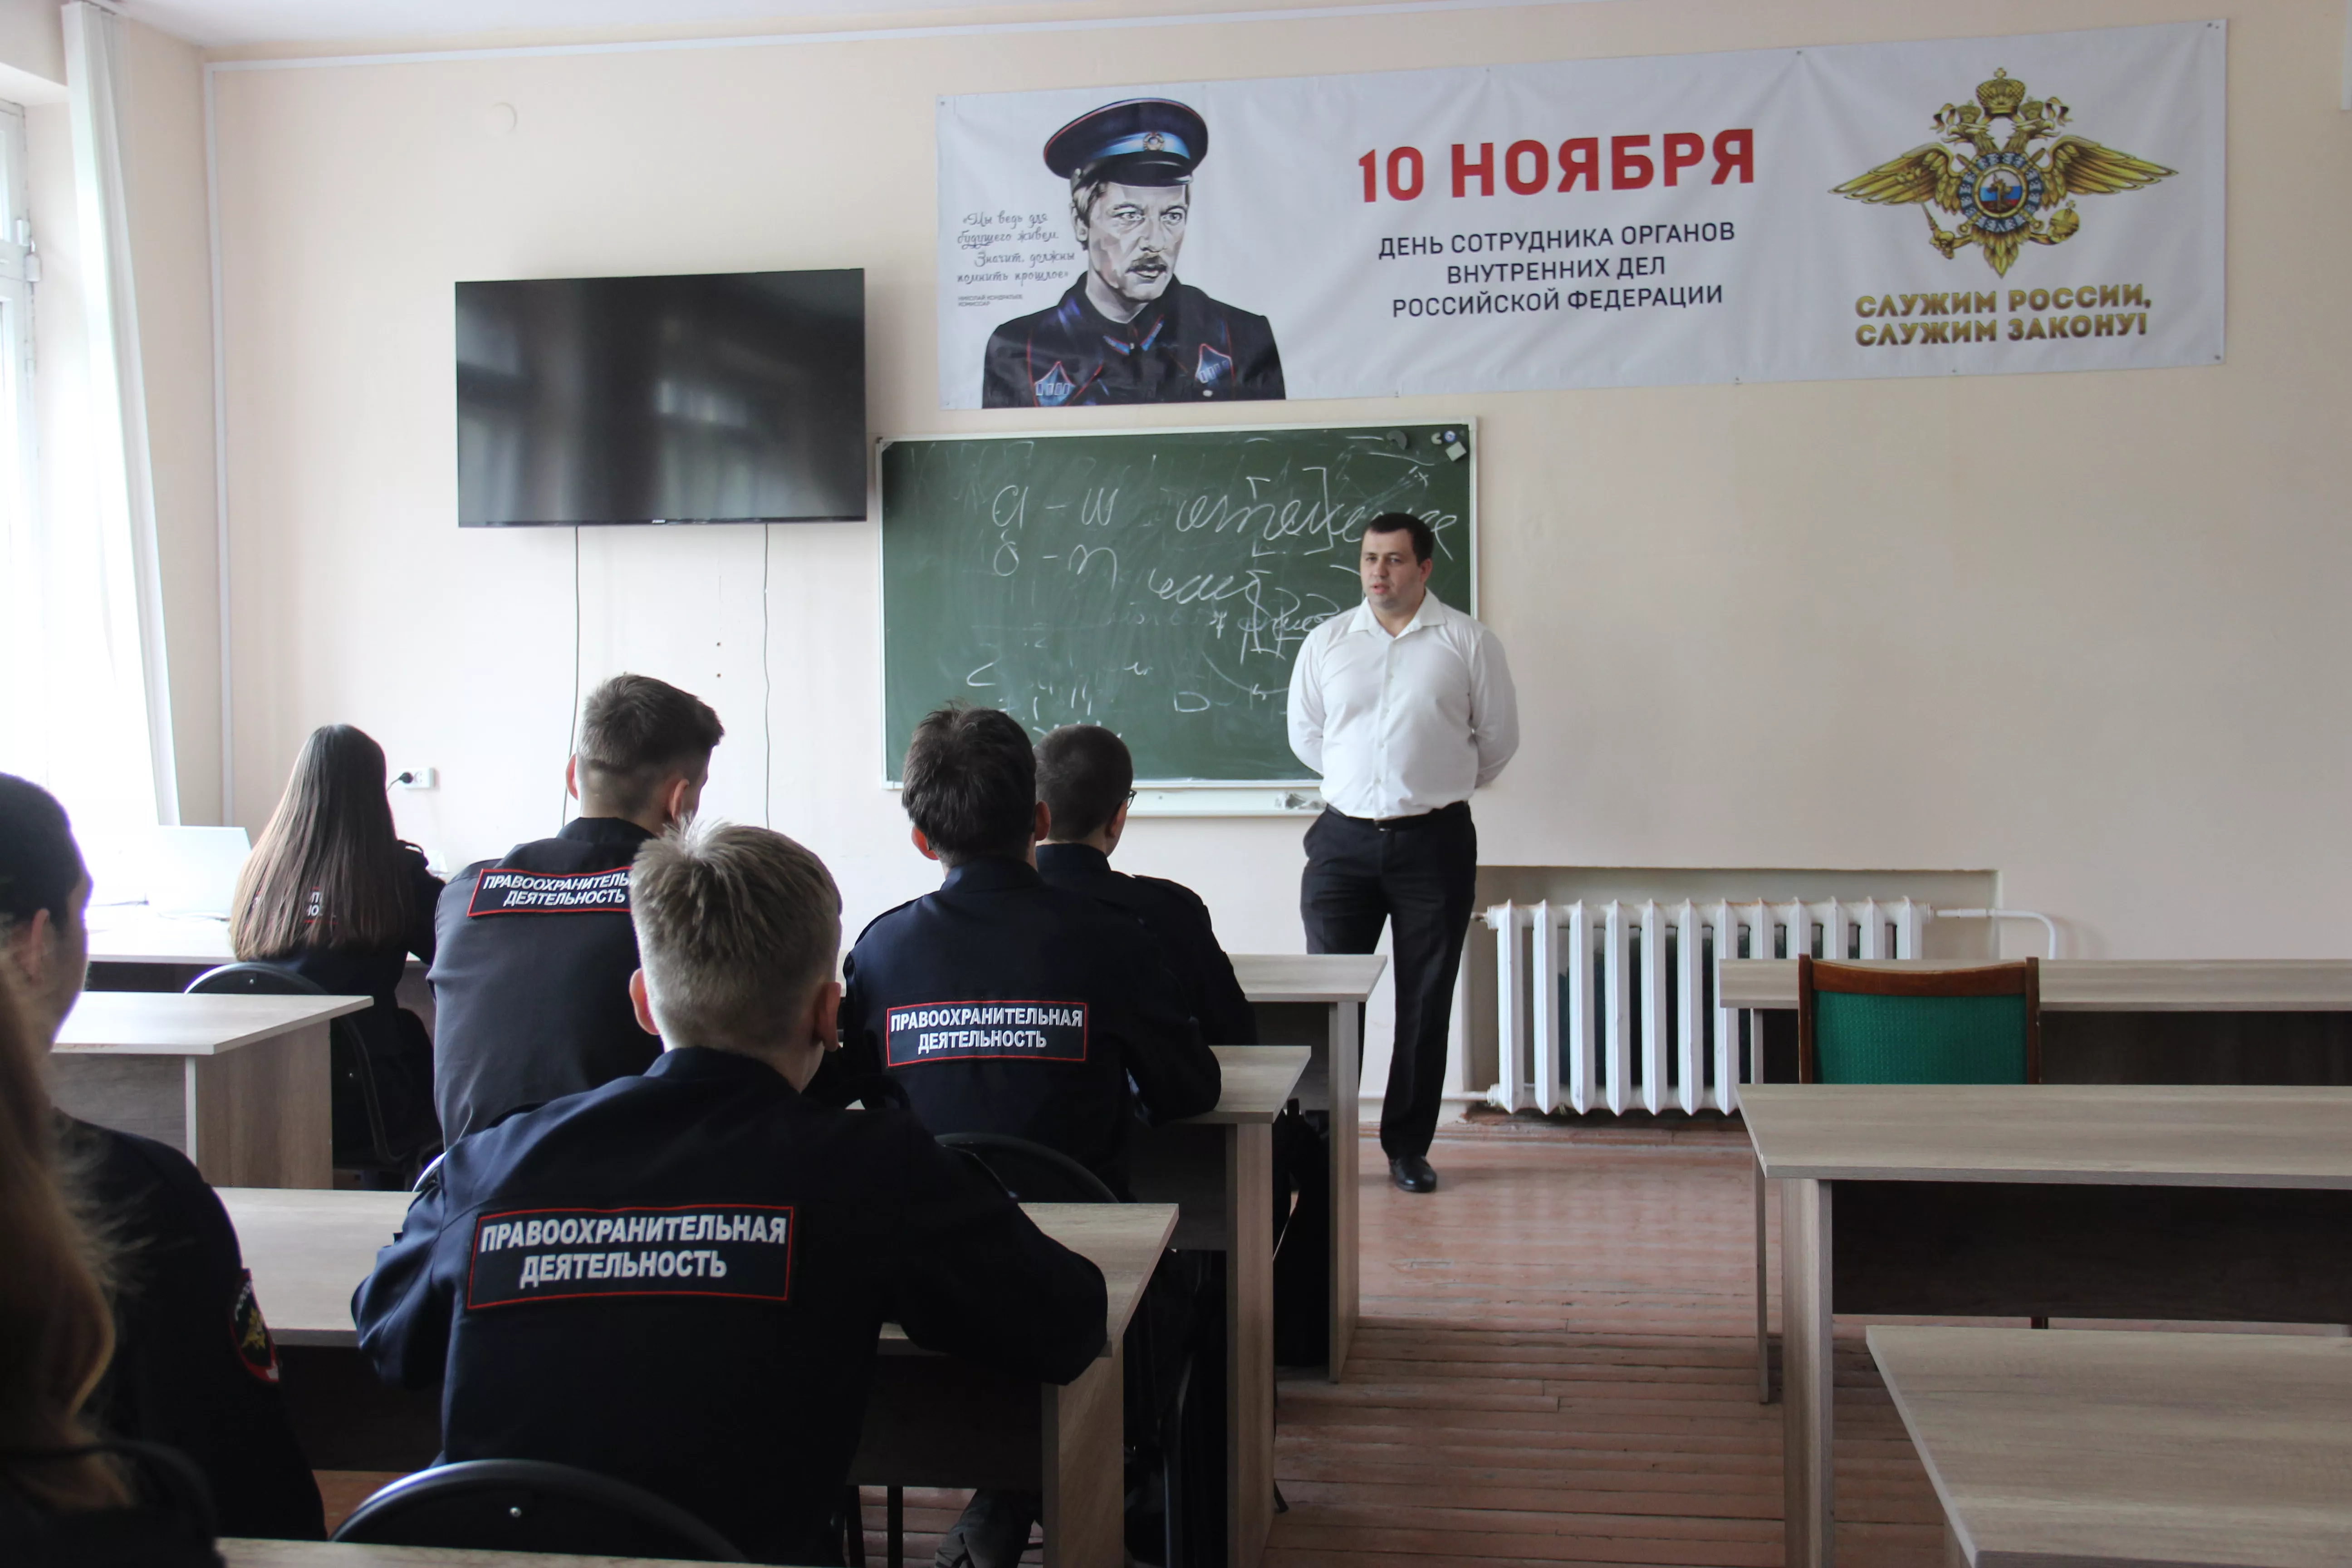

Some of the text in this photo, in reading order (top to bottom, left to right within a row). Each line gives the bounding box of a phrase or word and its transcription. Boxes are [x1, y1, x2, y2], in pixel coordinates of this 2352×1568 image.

[1358, 128, 1754, 202] 10 НОЯБРЯ
[997, 210, 1023, 230] ведь
[1029, 213, 1048, 229] для
[957, 229, 1013, 250] будущего
[1379, 221, 1735, 260] ДЕНЬ СОТРУДНИКА ОРГАНОВ
[1029, 250, 1075, 269] должны
[1447, 256, 1666, 284] ВНУТРЕННИХ ДЕЛ
[957, 271, 1009, 285] помнить
[1392, 285, 1723, 318] РОССИЙСКОЙ ФЕДЕРАЦИИ
[1855, 284, 2151, 318] СЛУЖИМ РОССИИ,
[1855, 313, 2147, 346] СЛУЖИМ ЗАКОНУ!
[483, 872, 629, 891] ПРАВООХРАНИТЕЛЬ
[503, 888, 626, 907] ДЕЯТЕЛЬНОСТЬ
[890, 1008, 1083, 1032] ПРАВООХРАНИТЕЛЬНАЯ
[918, 1030, 1047, 1055] ДЕЯТЕЛЬНОСТЬ
[480, 1215, 787, 1252] ПРАВООХРАНИТЕЛЬНАЯ
[519, 1250, 727, 1289] ДЕЯТЕЛЬНОСТЬ
